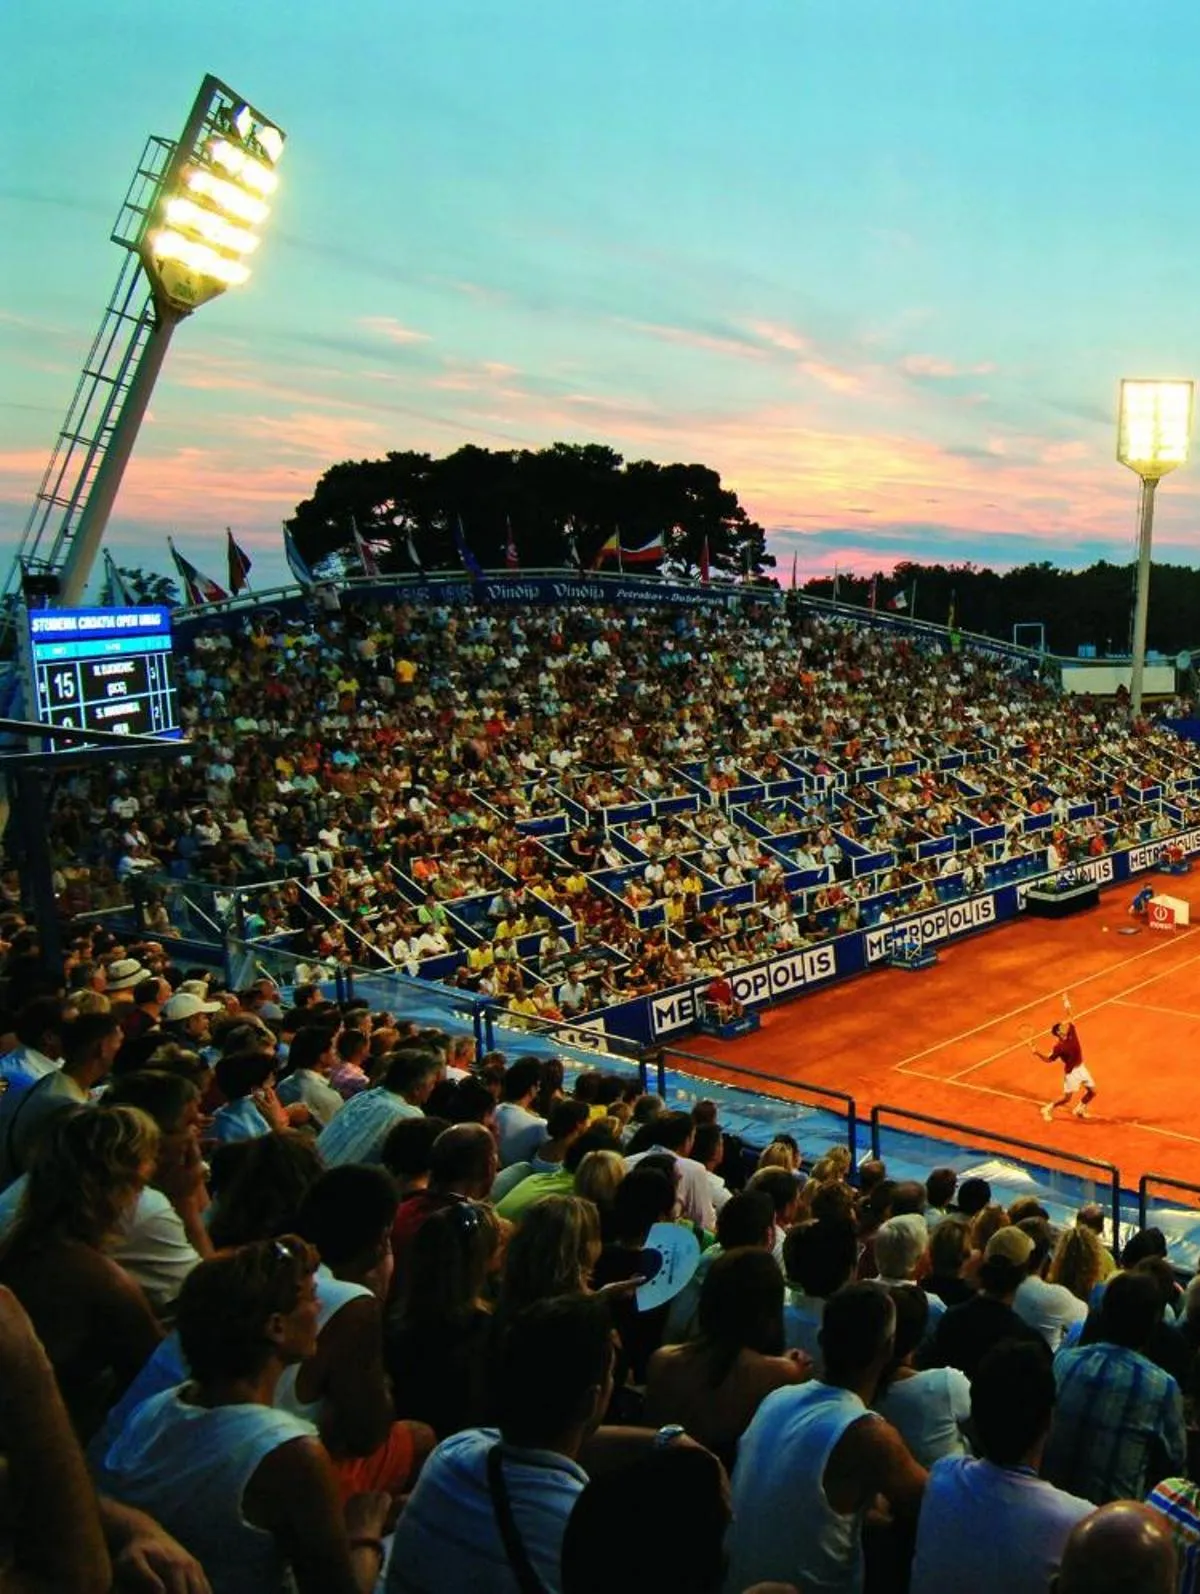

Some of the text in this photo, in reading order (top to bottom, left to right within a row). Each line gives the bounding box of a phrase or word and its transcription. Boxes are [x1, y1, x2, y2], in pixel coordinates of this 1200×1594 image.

[54, 672, 75, 699] 15
[154, 706, 160, 719] 2
[869, 901, 991, 957] MEROPOLIS
[655, 951, 832, 1028] MEOPOLIS
